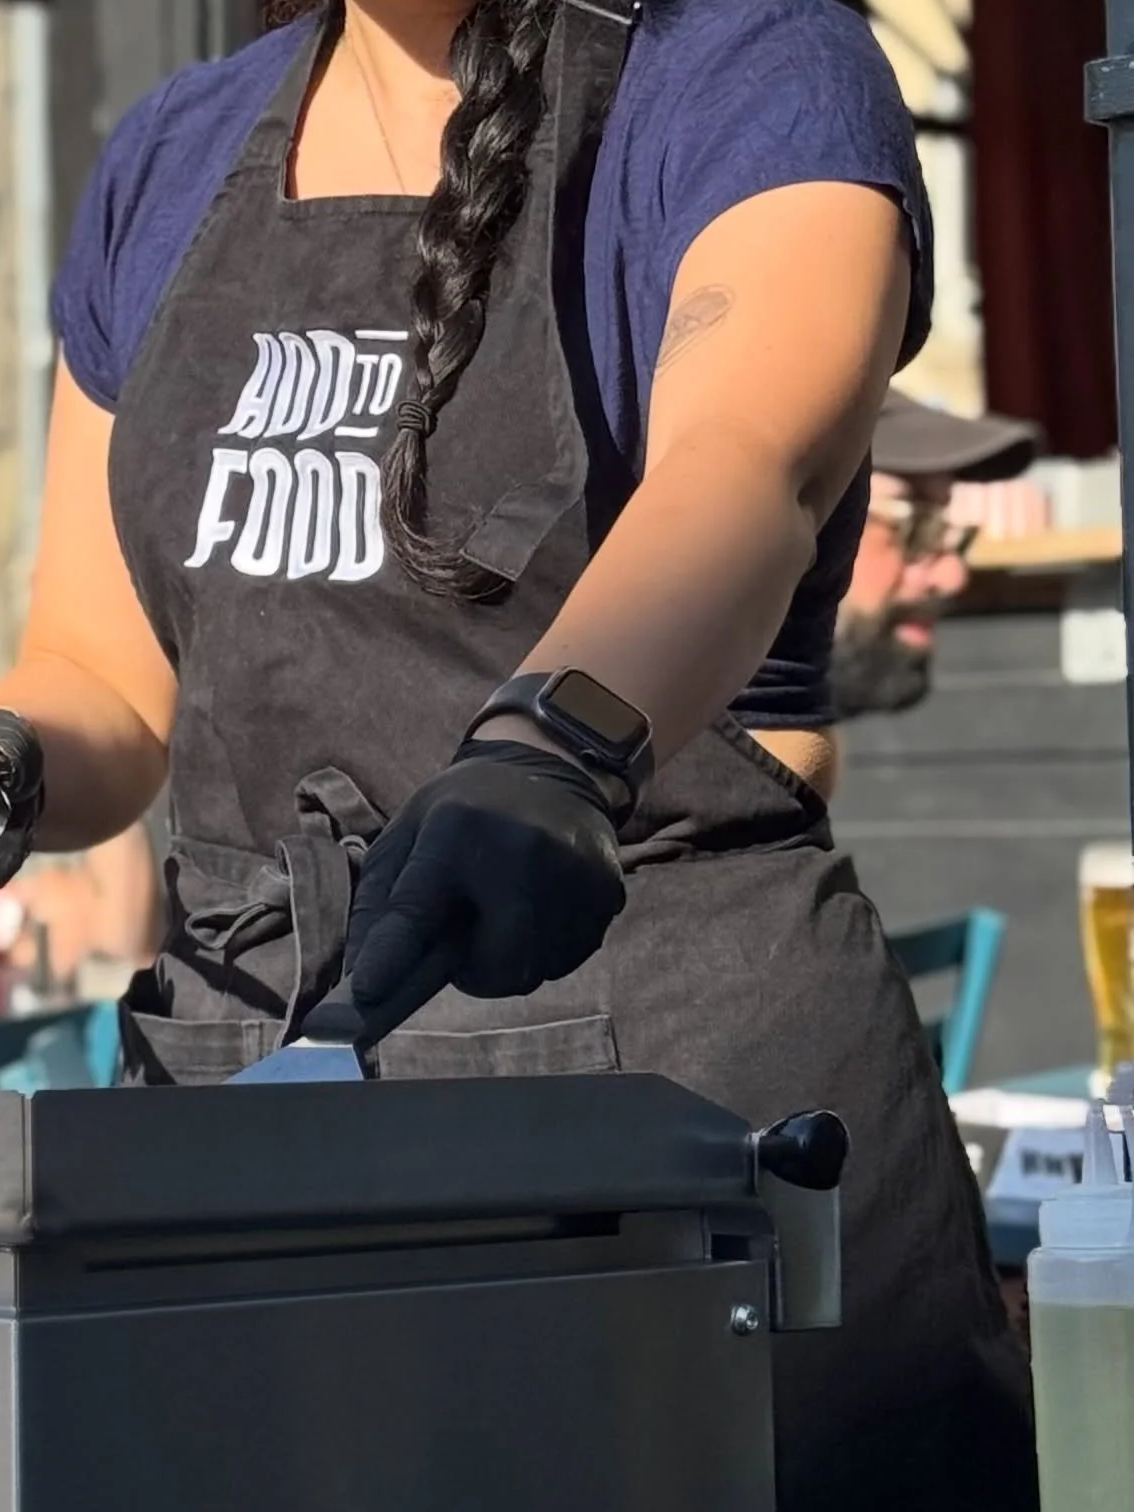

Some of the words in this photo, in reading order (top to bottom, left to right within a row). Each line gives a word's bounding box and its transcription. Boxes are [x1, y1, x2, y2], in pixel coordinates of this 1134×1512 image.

[217, 329, 355, 441] ADD
[353, 352, 403, 416] TO
[183, 446, 385, 582] FOOD
